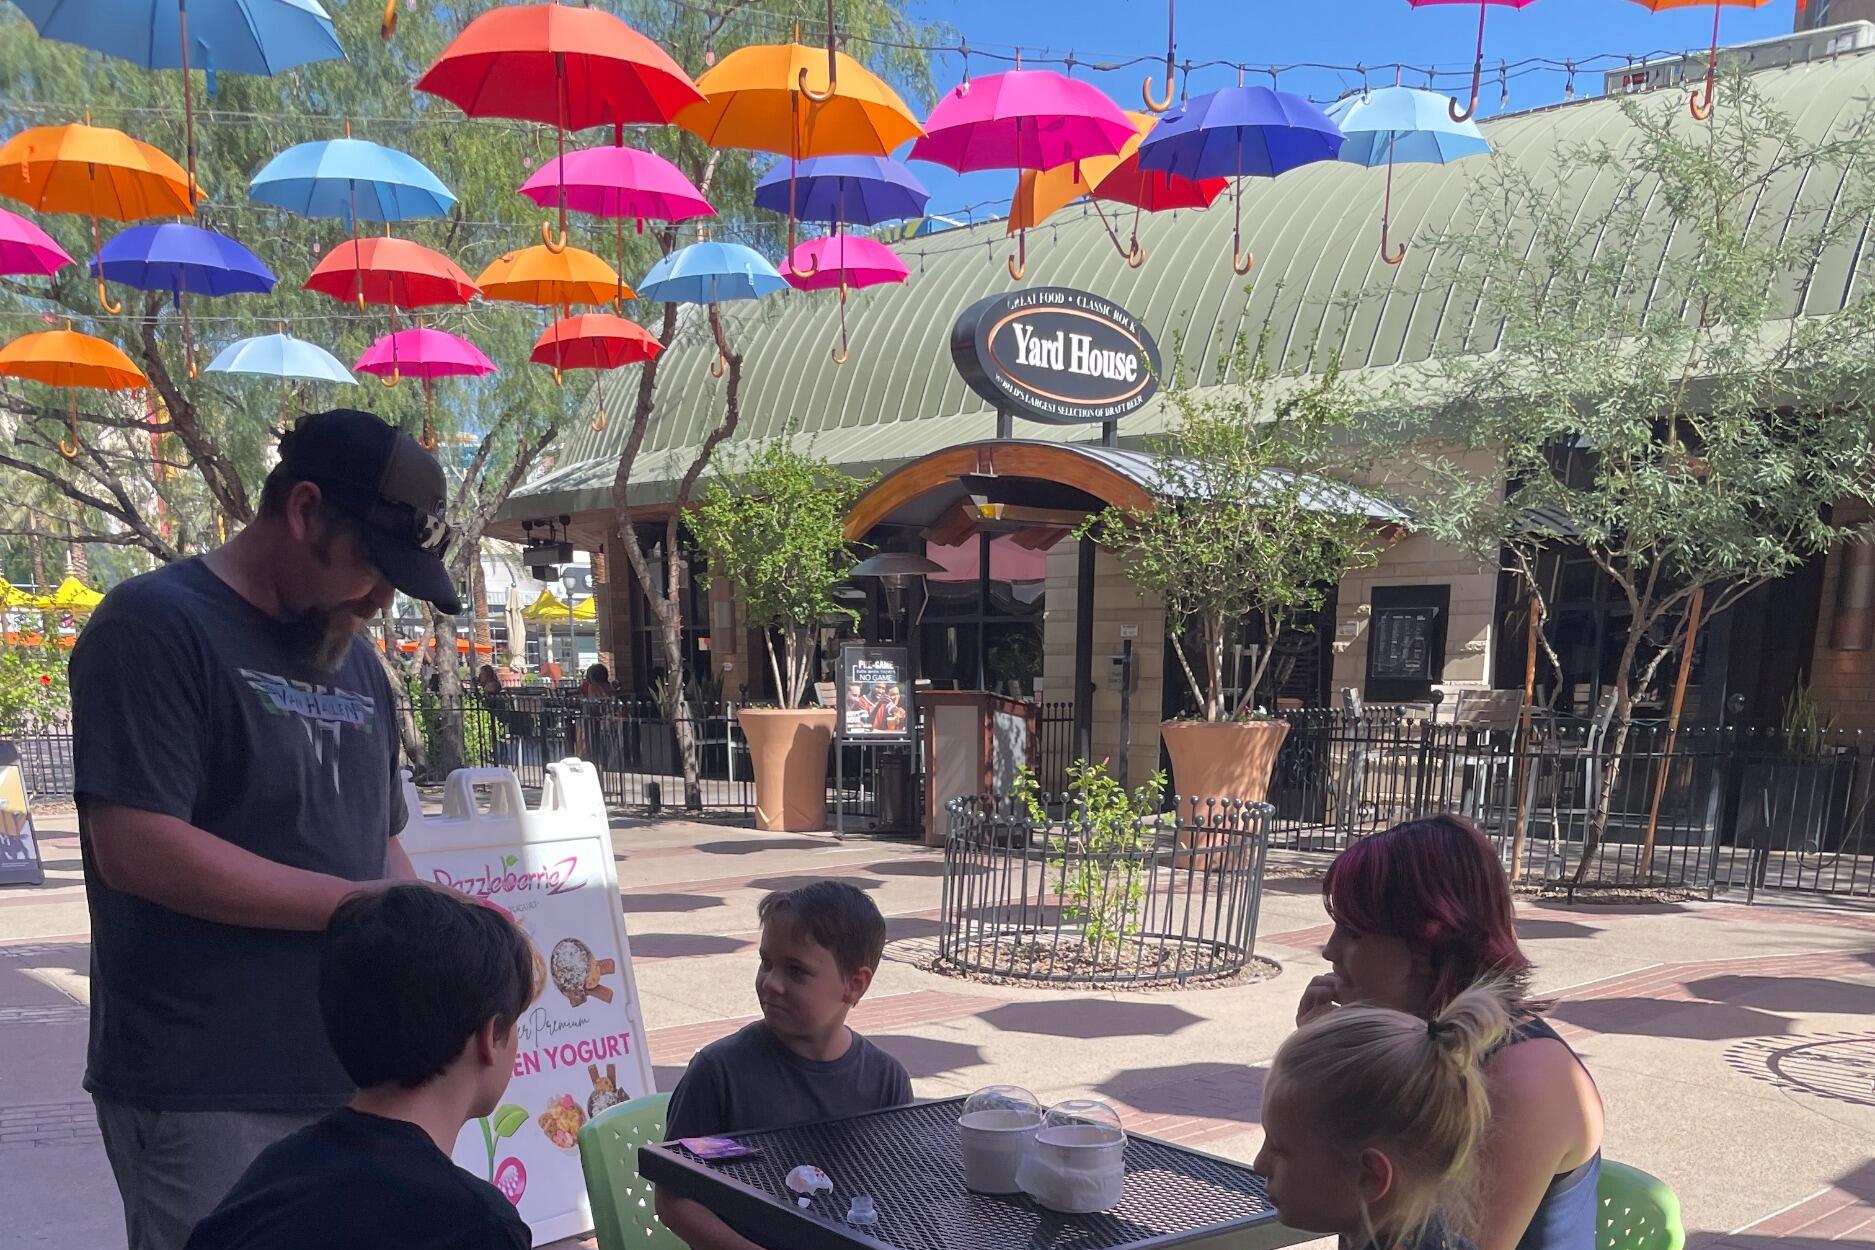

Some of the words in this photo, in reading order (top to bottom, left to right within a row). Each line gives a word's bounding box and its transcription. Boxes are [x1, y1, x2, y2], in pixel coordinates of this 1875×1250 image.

[1040, 292, 1065, 304] FOOD
[1077, 296, 1111, 317] CLASSIC
[1113, 310, 1136, 333] ROCK
[1012, 323, 1065, 370] Yard
[1068, 333, 1137, 382] House
[1024, 394, 1056, 412] LARGEST
[1057, 407, 1095, 418] SELECTION
[1095, 407, 1104, 417] OF
[1105, 405, 1126, 416] DRAFT
[1126, 394, 1143, 409] BEER
[530, 1007, 590, 1048] Premium
[543, 1032, 630, 1070] YOGURT
